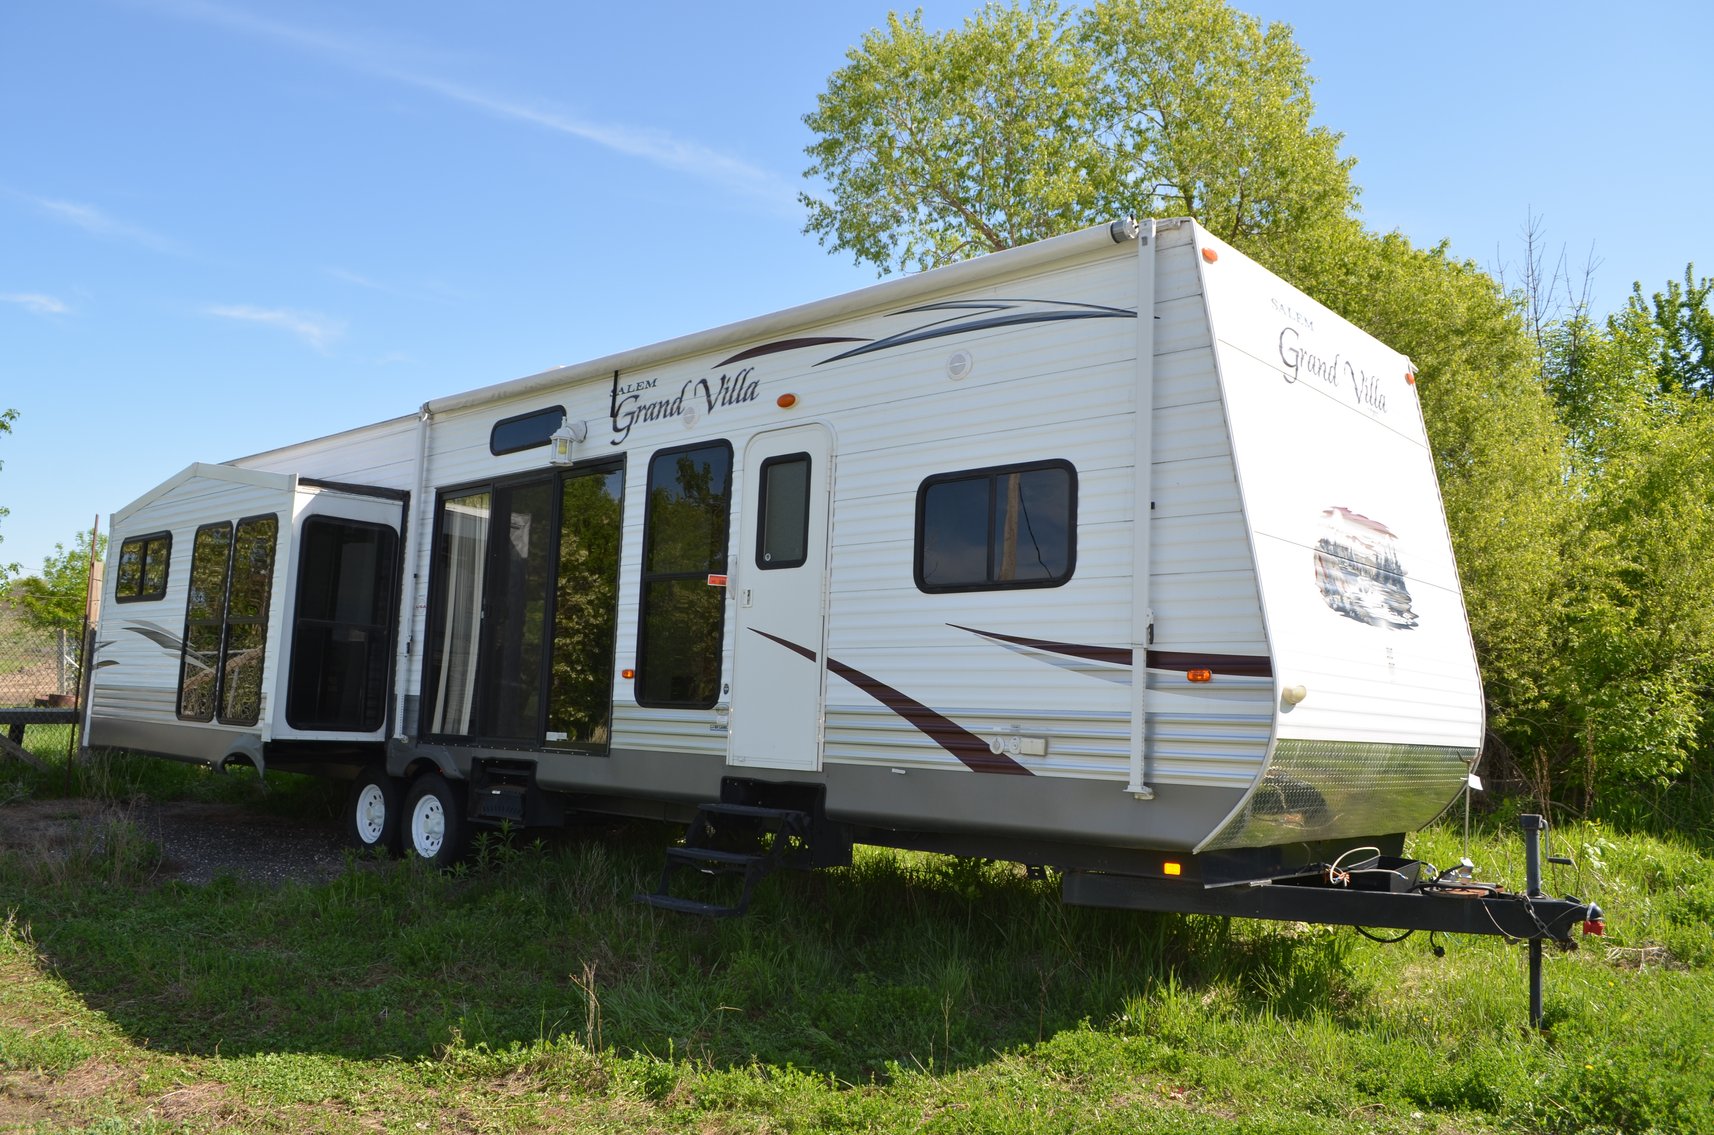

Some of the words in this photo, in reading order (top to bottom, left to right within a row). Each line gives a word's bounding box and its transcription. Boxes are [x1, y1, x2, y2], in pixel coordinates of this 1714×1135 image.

[1271, 298, 1314, 331] SALEM
[610, 380, 692, 445] Grand
[694, 367, 760, 415] Villa
[1279, 327, 1340, 387] Grand
[1344, 361, 1387, 413] Villa
